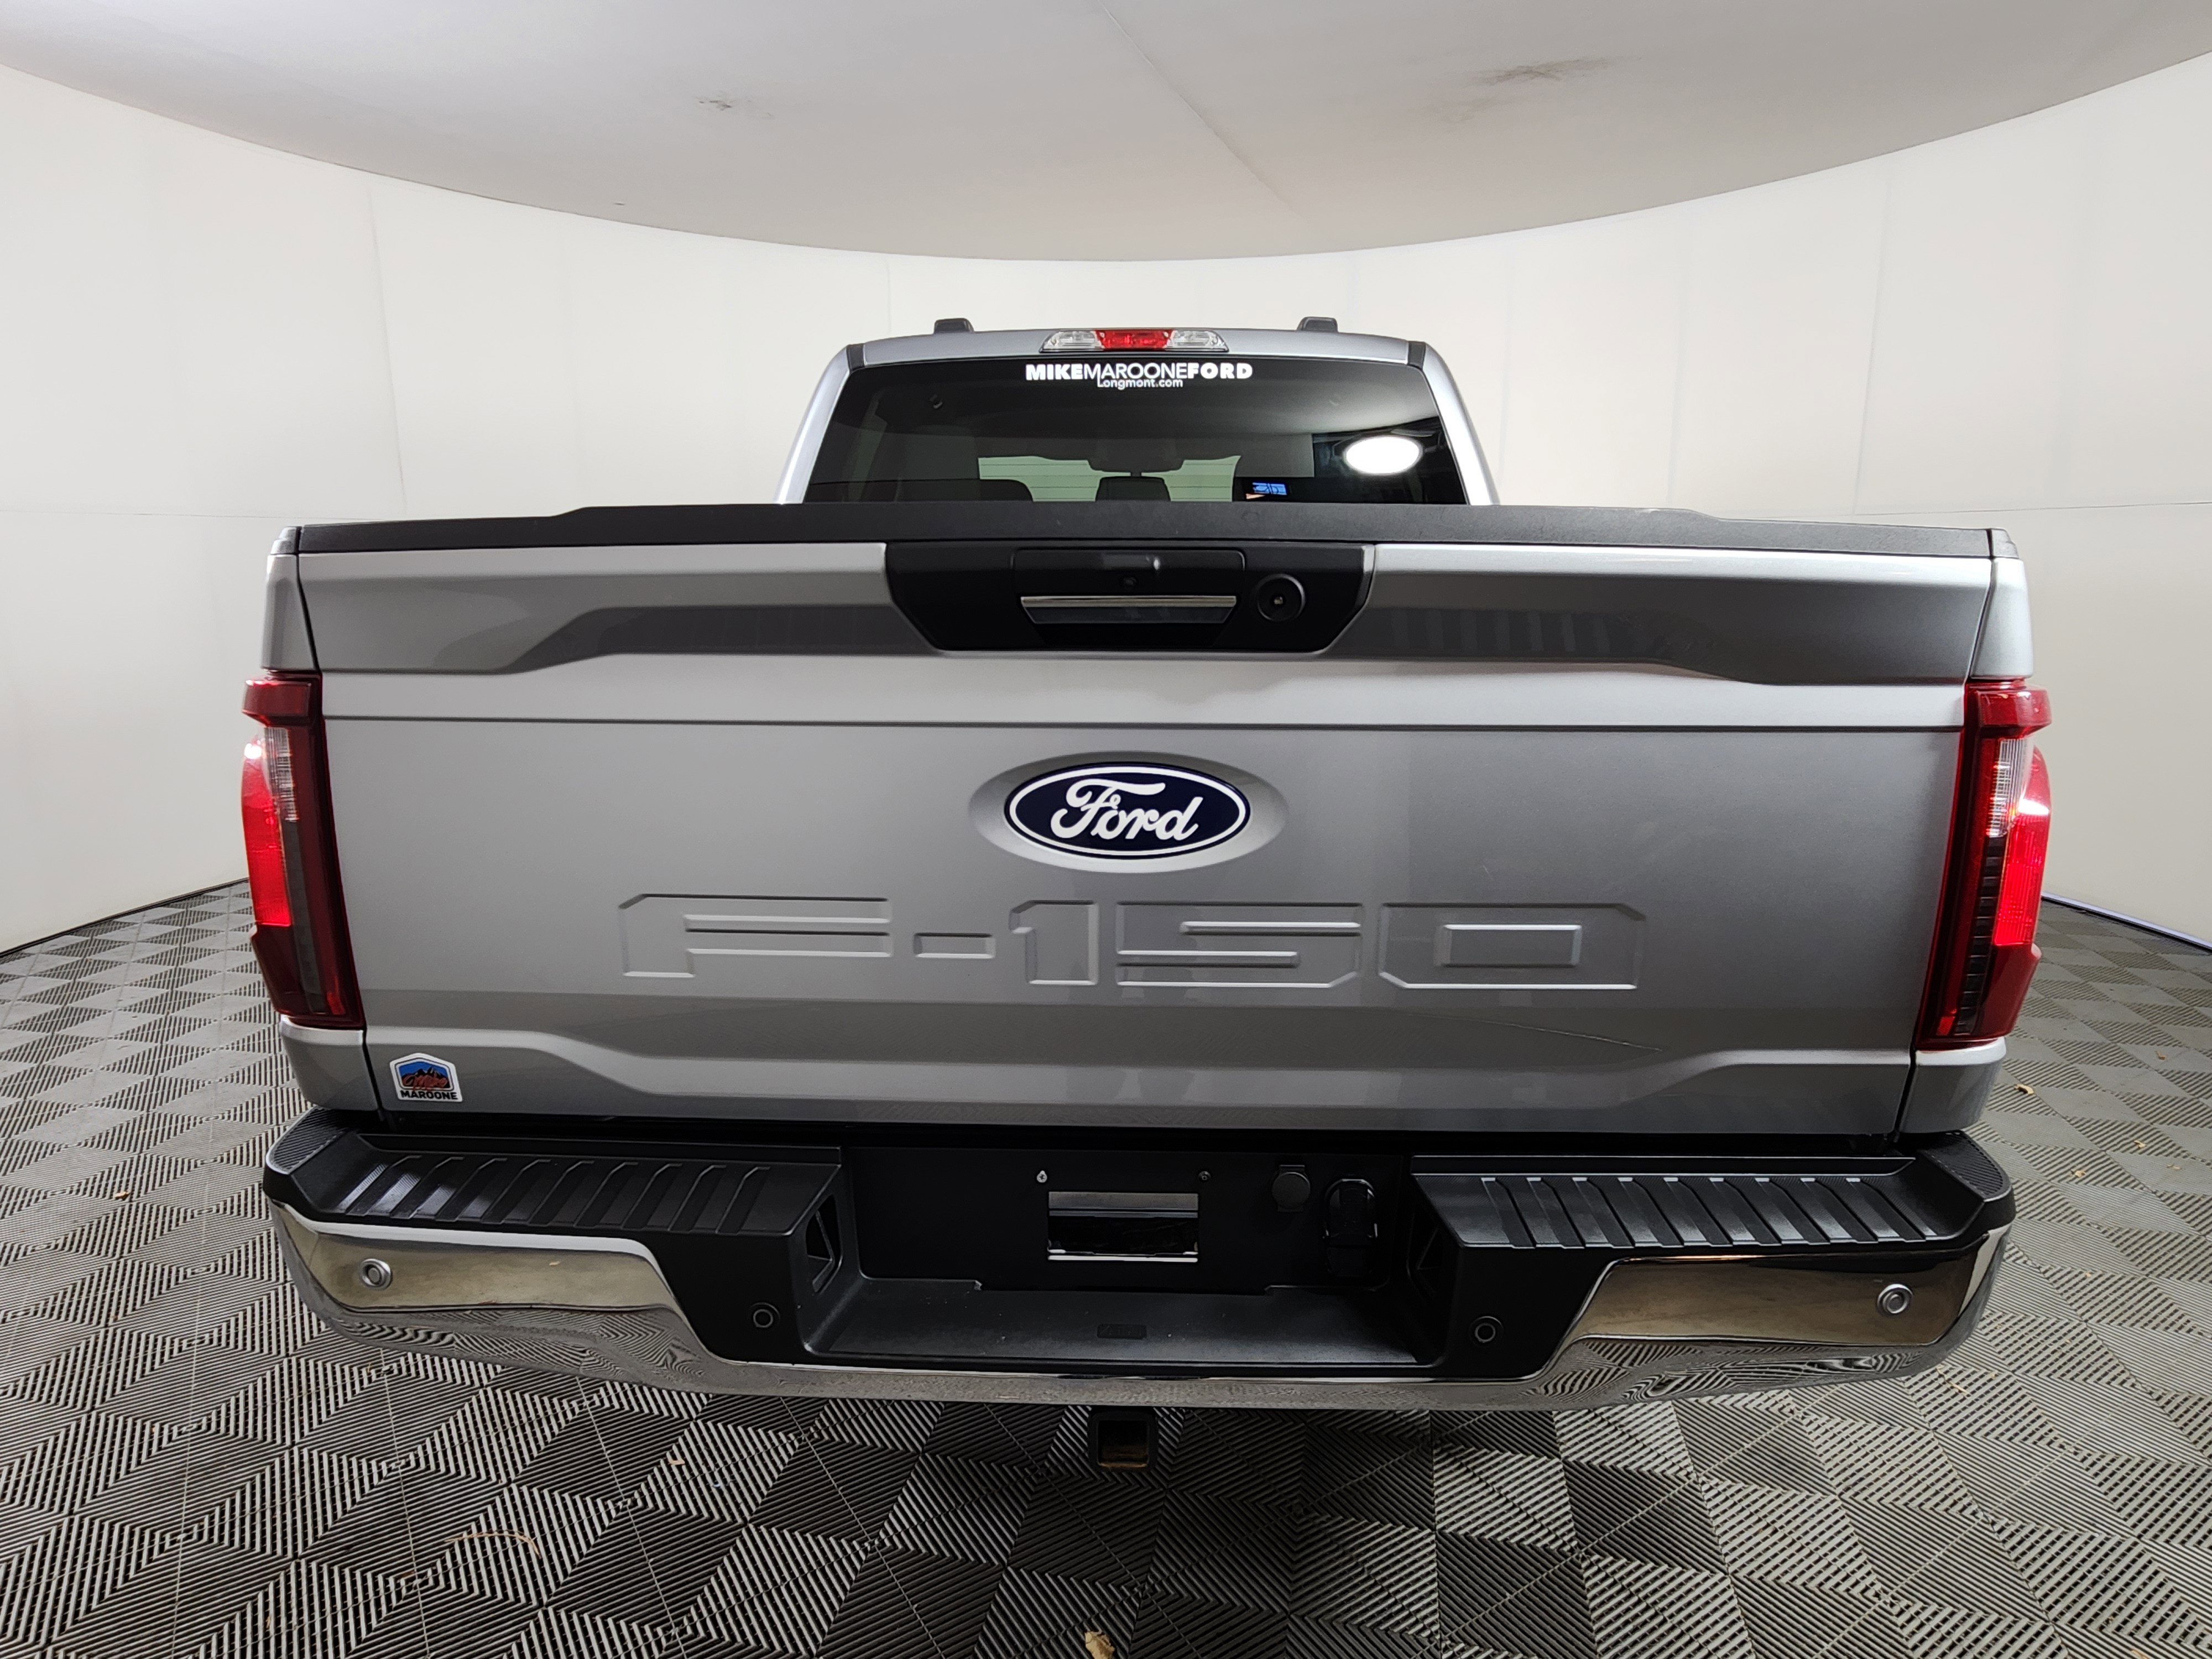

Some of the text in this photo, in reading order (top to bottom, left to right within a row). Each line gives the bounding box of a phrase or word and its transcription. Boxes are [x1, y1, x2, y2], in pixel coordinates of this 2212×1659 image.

[1097, 378, 1183, 390] Longmont.com
[1050, 779, 1199, 841] Ford
[619, 893, 1646, 989] F-150
[401, 1091, 458, 1100] MAROONE
